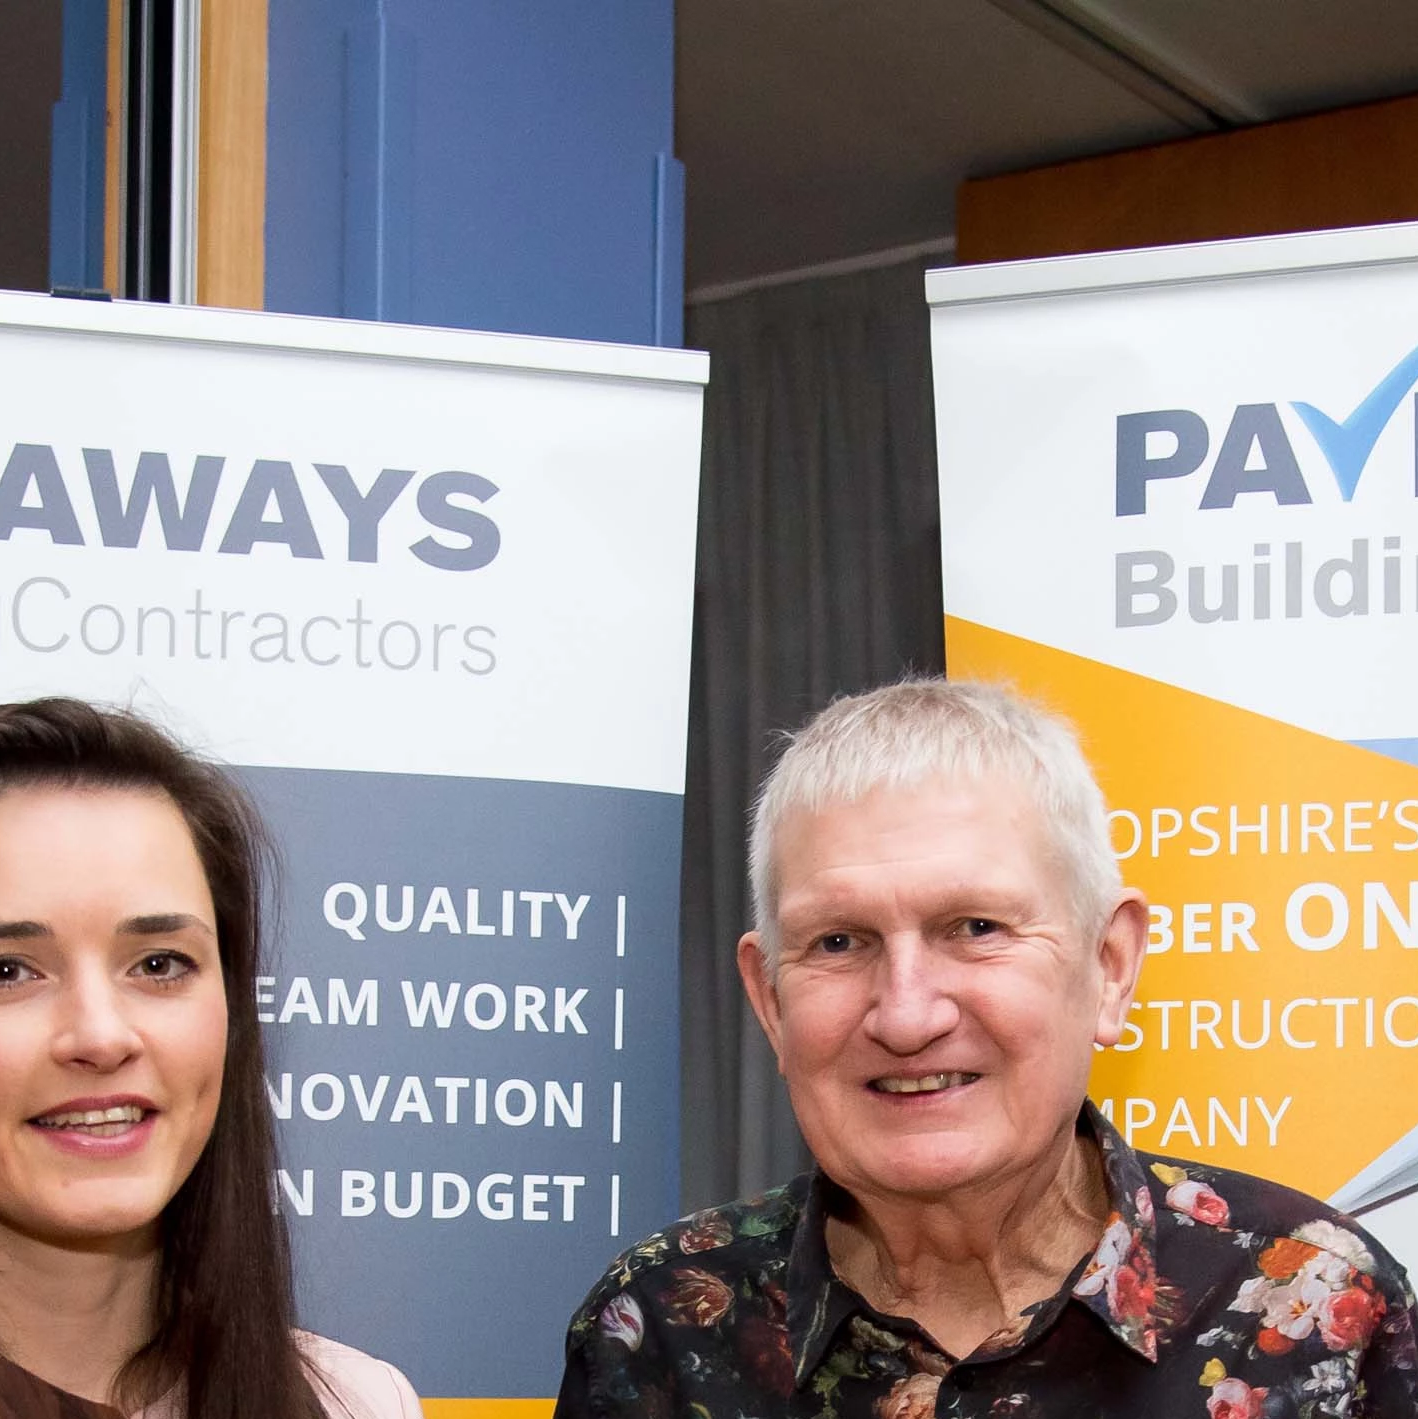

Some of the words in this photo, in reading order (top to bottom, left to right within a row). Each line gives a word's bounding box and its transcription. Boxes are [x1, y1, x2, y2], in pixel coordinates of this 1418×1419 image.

[321, 881, 592, 942] QUALITY
[1145, 901, 1261, 955] BER
[255, 976, 380, 1027] EAM
[400, 980, 591, 1036] WORK
[264, 1072, 585, 1130] NOVATION
[272, 1168, 315, 1218] N
[340, 1169, 586, 1223] BUDGET
